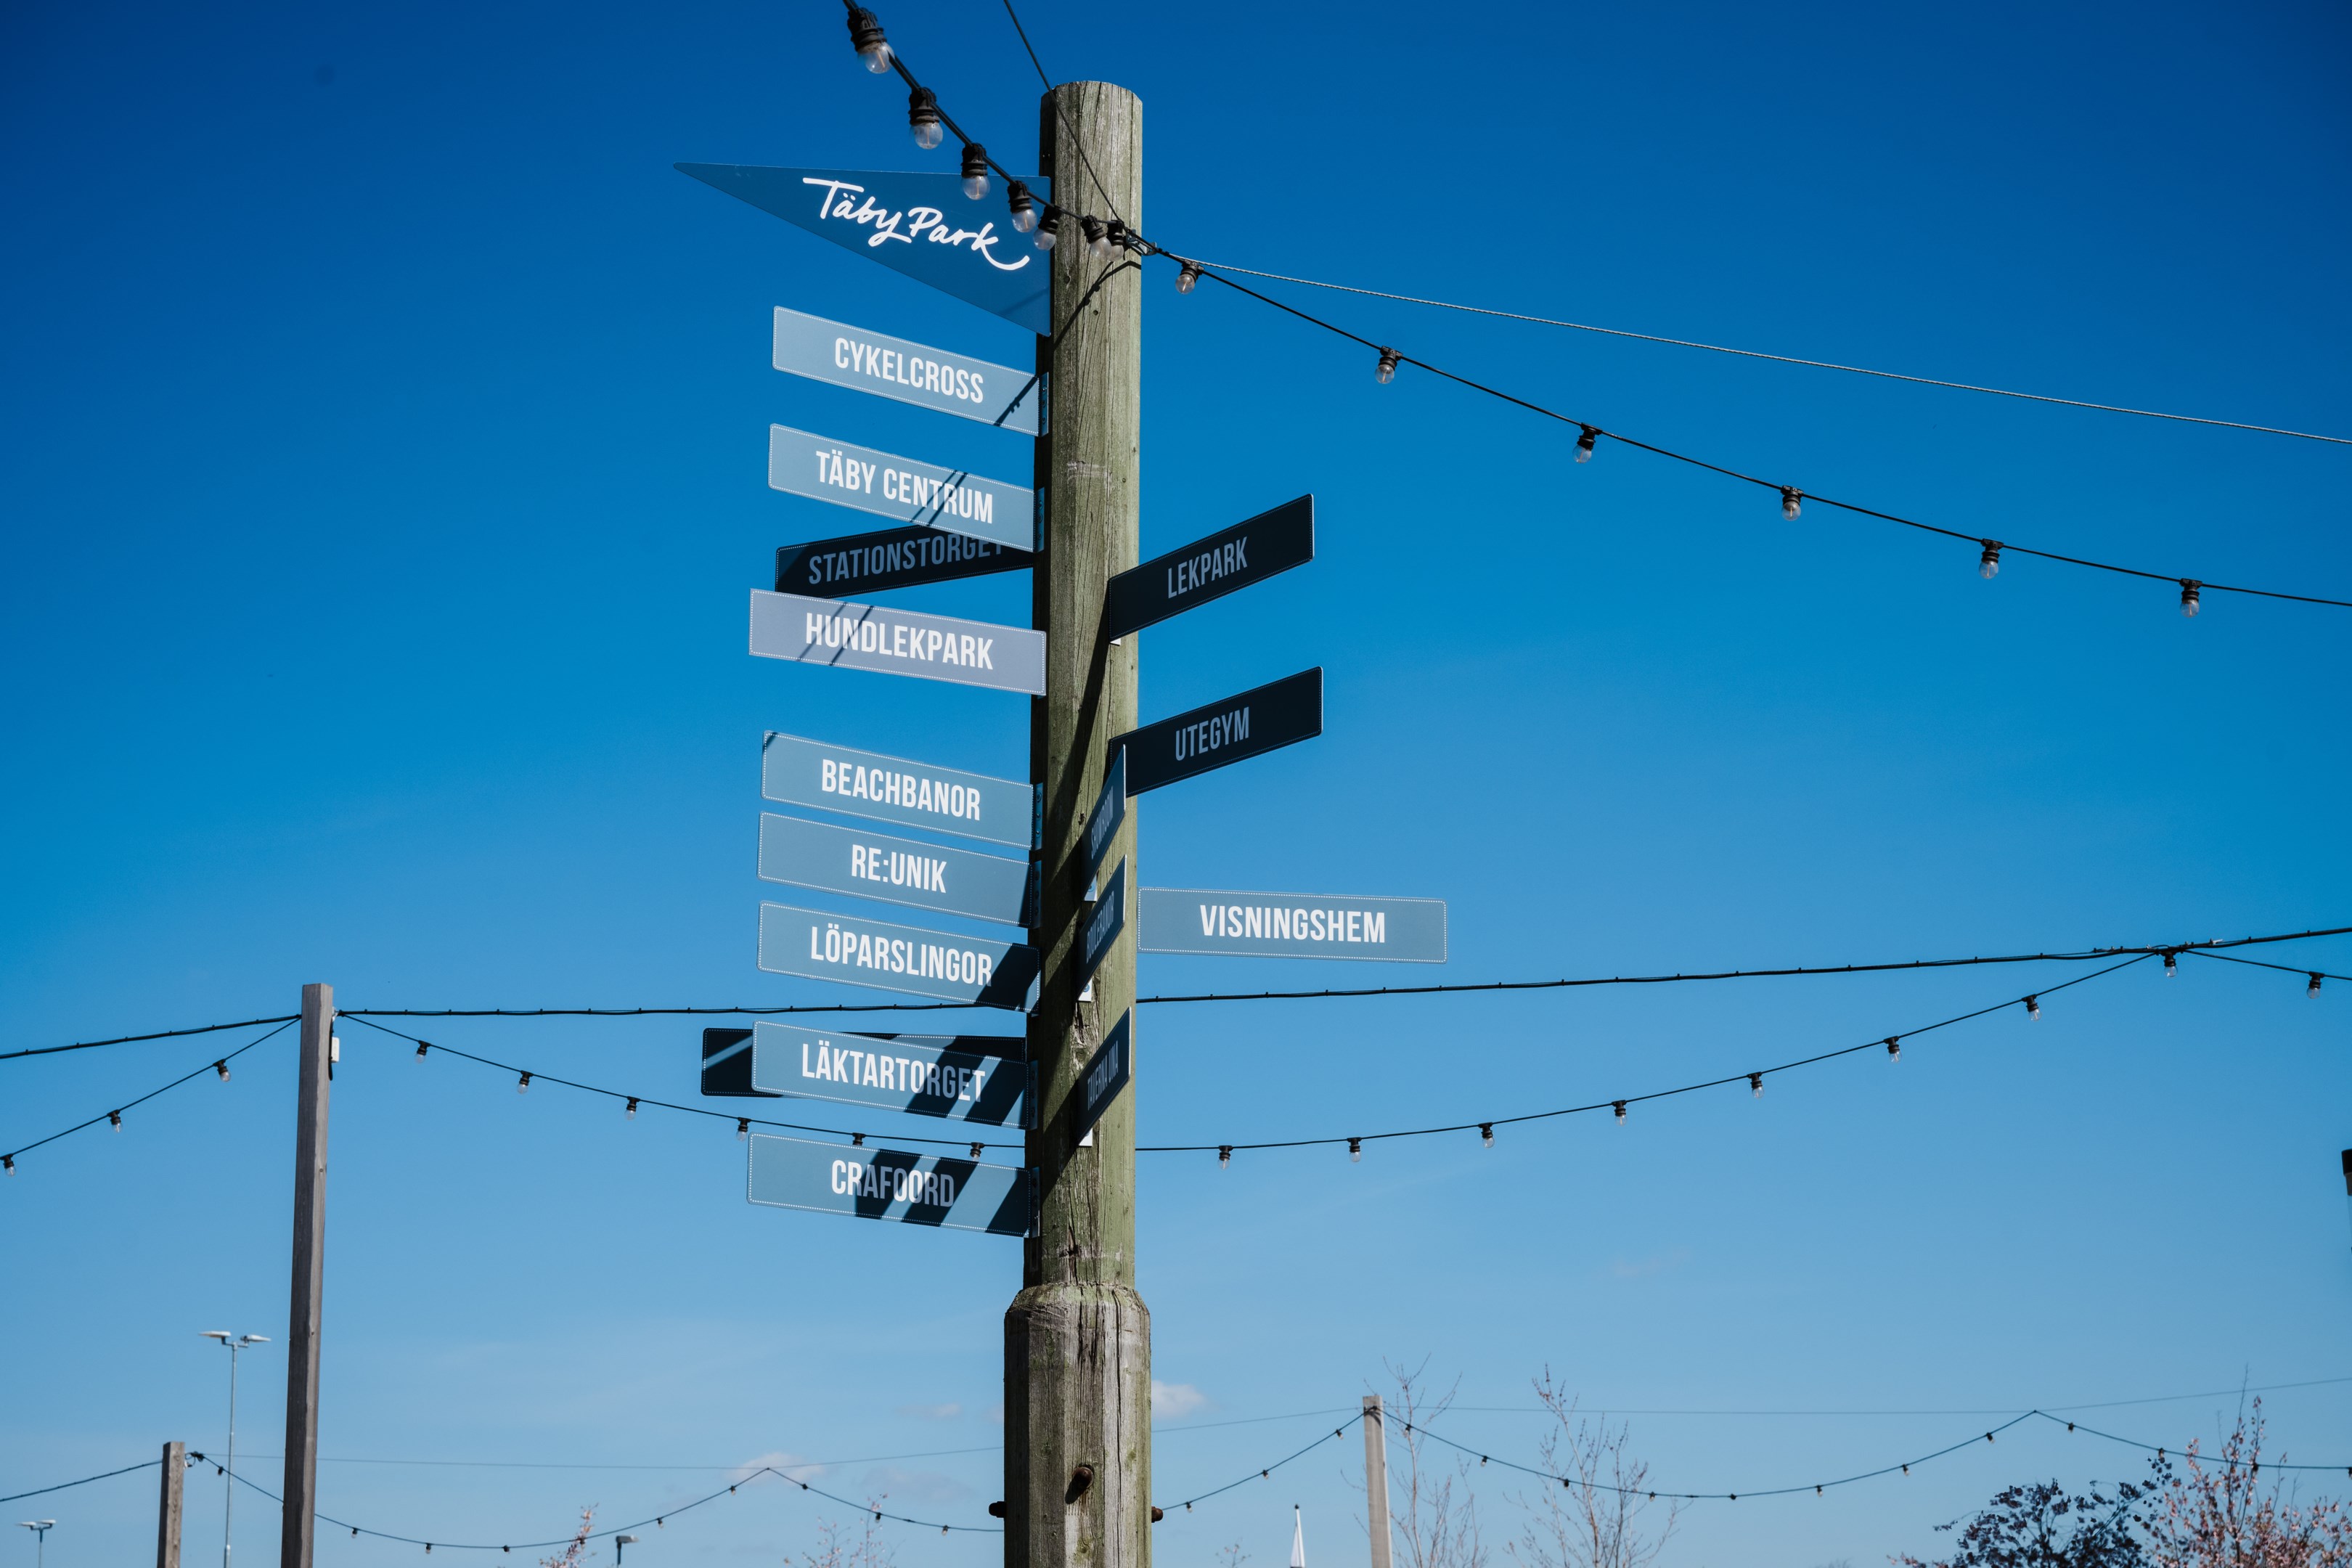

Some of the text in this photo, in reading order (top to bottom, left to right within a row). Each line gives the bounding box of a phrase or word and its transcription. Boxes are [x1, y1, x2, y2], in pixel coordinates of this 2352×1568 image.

[803, 177, 1030, 271] Täby Park
[835, 338, 984, 404] CYKELCROSS
[816, 449, 993, 524] TÄBY CENTRUM
[1168, 536, 1248, 599] LEKPARK
[806, 613, 994, 670] HUNDLEKPARK
[1175, 706, 1249, 761] UTEGYM
[822, 759, 981, 821] BEACHBANOR
[1091, 785, 1114, 859] SHOWROOM
[852, 844, 947, 894] RE:UNIK
[811, 923, 992, 987] LÖPARSLINGOR
[1199, 905, 1386, 944] VISNINGSHEM
[802, 1040, 986, 1103] LÄKTARTORGET
[831, 1159, 955, 1208] CRAFOORD
